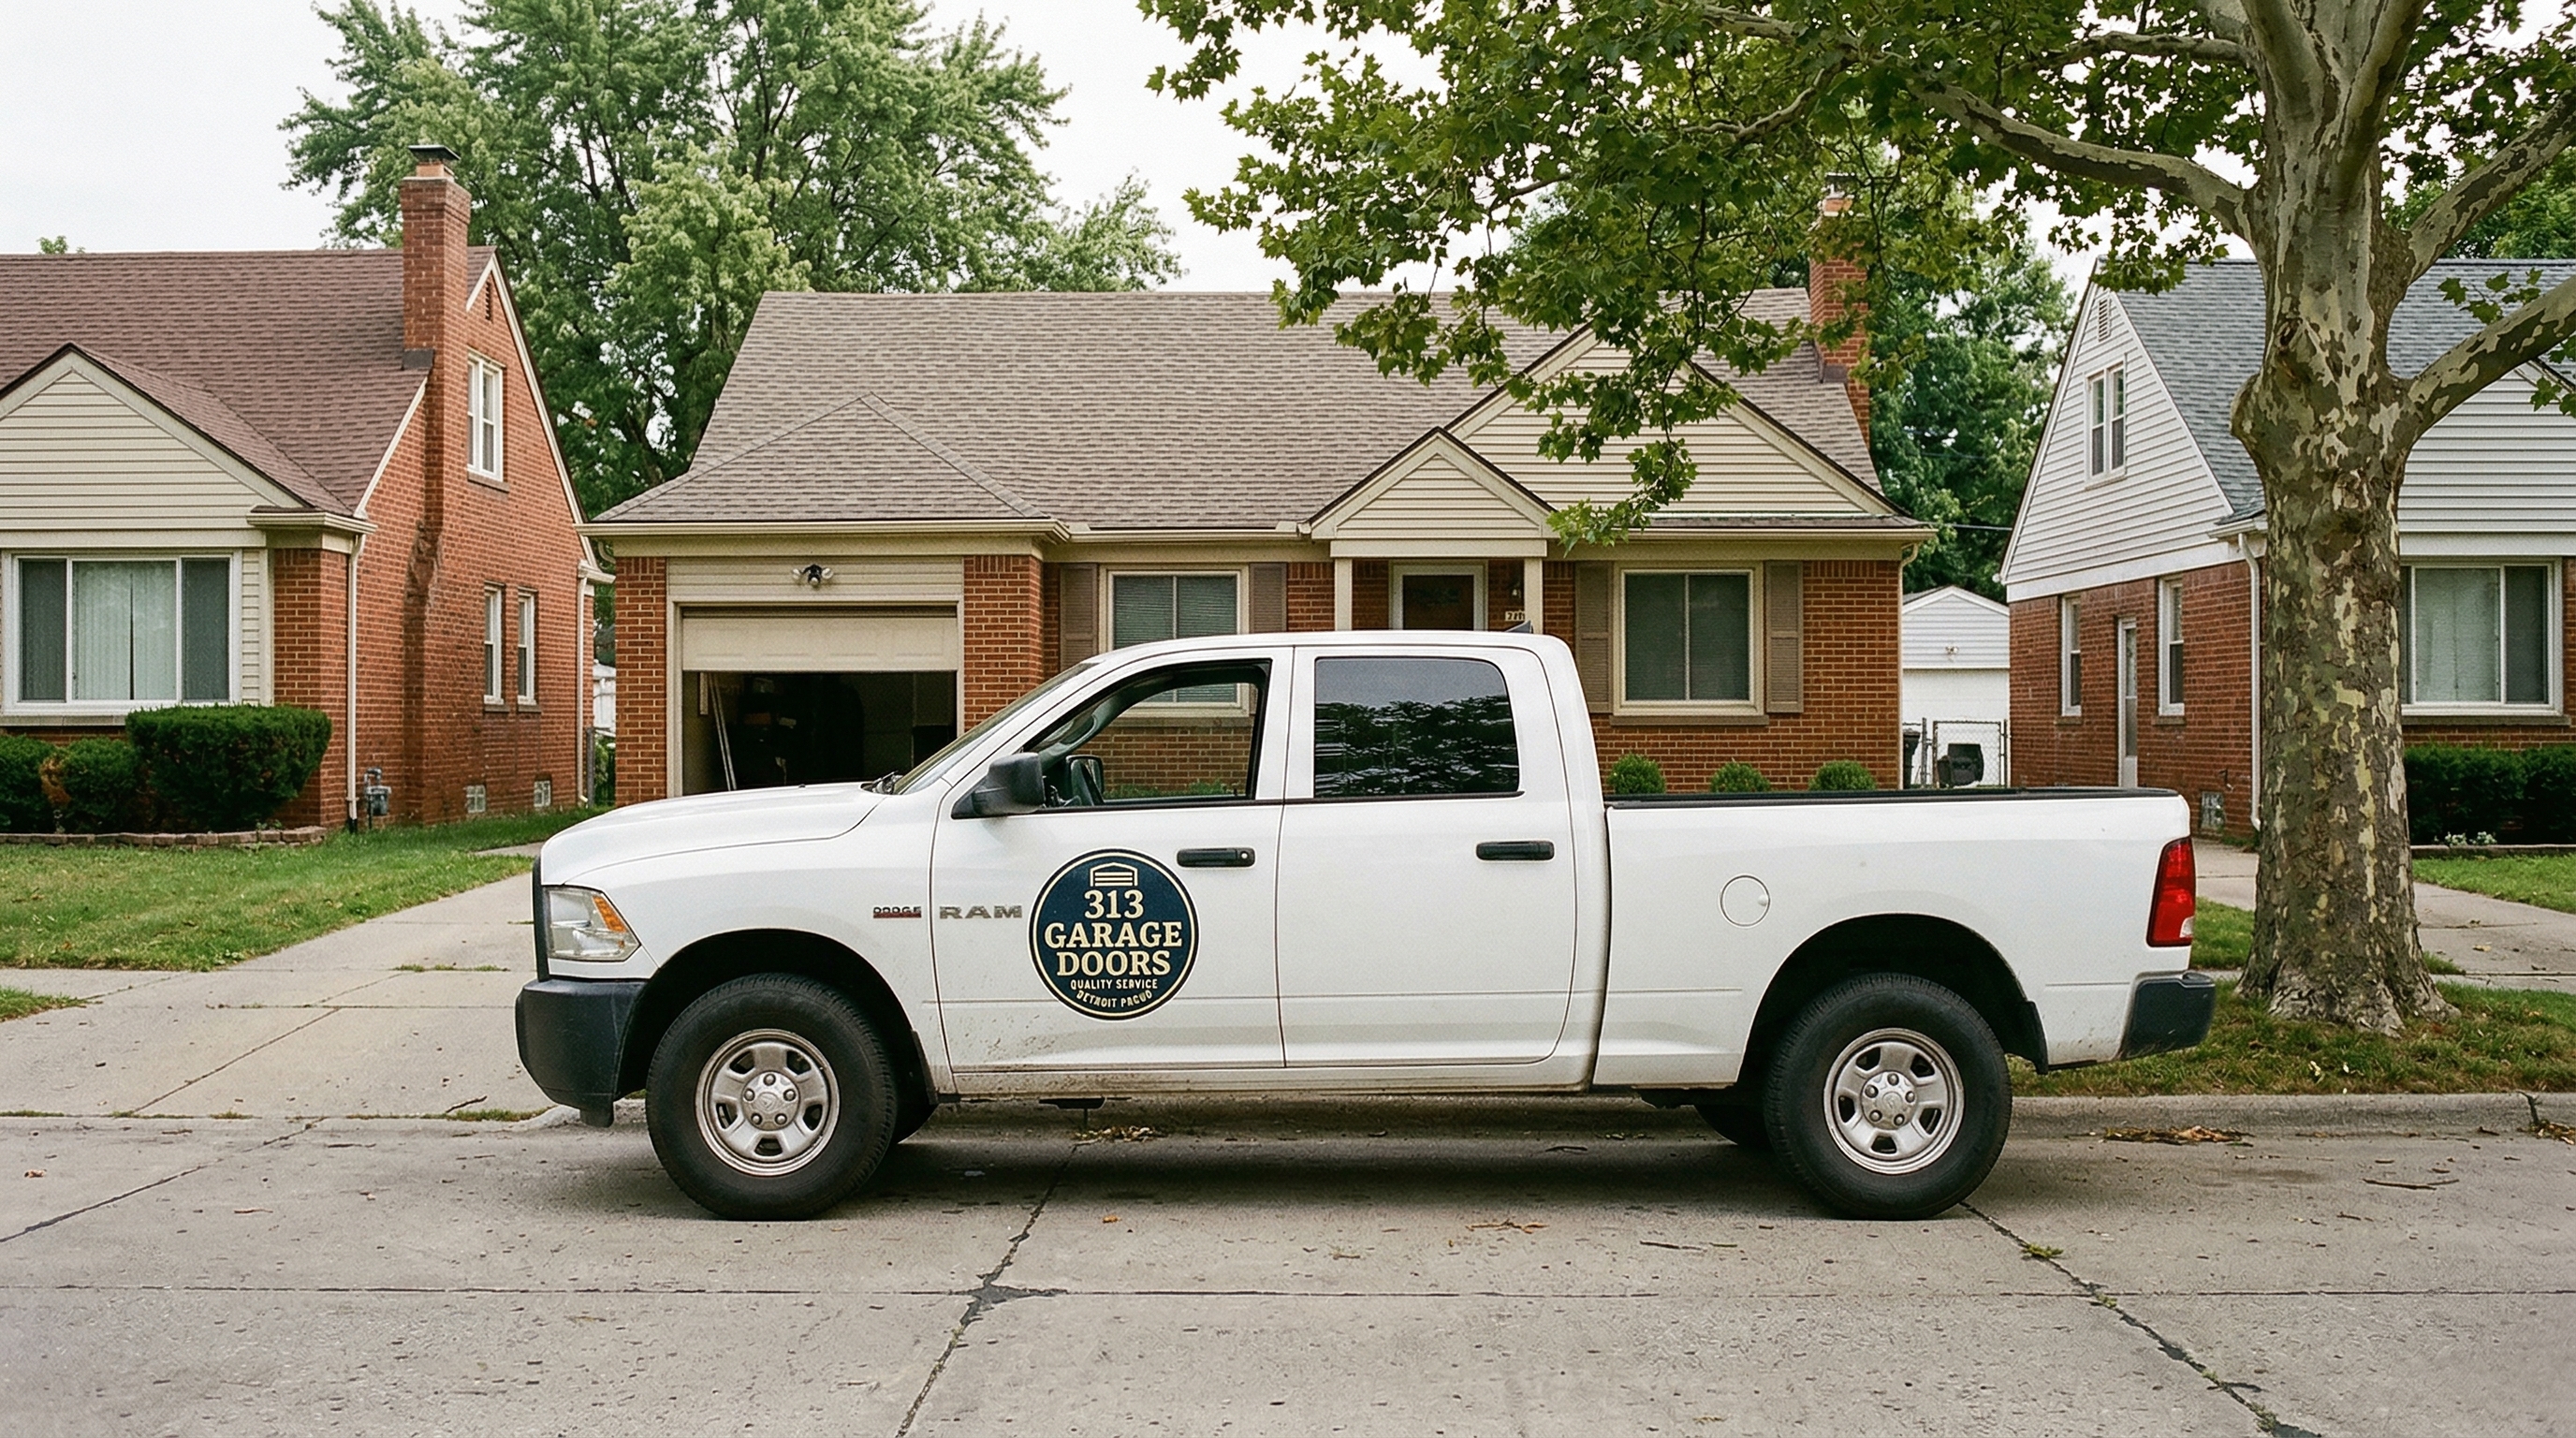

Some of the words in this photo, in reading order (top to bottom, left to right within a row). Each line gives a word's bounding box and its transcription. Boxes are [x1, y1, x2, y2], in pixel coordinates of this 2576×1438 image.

[873, 906, 921, 915] DODGE
[939, 905, 1022, 918] RAM
[1084, 889, 1144, 918] 313
[1044, 921, 1182, 948] GARAGE
[1056, 950, 1171, 976] DOORS
[1070, 979, 1112, 990] QUALITY
[1116, 979, 1158, 990] SERVICE
